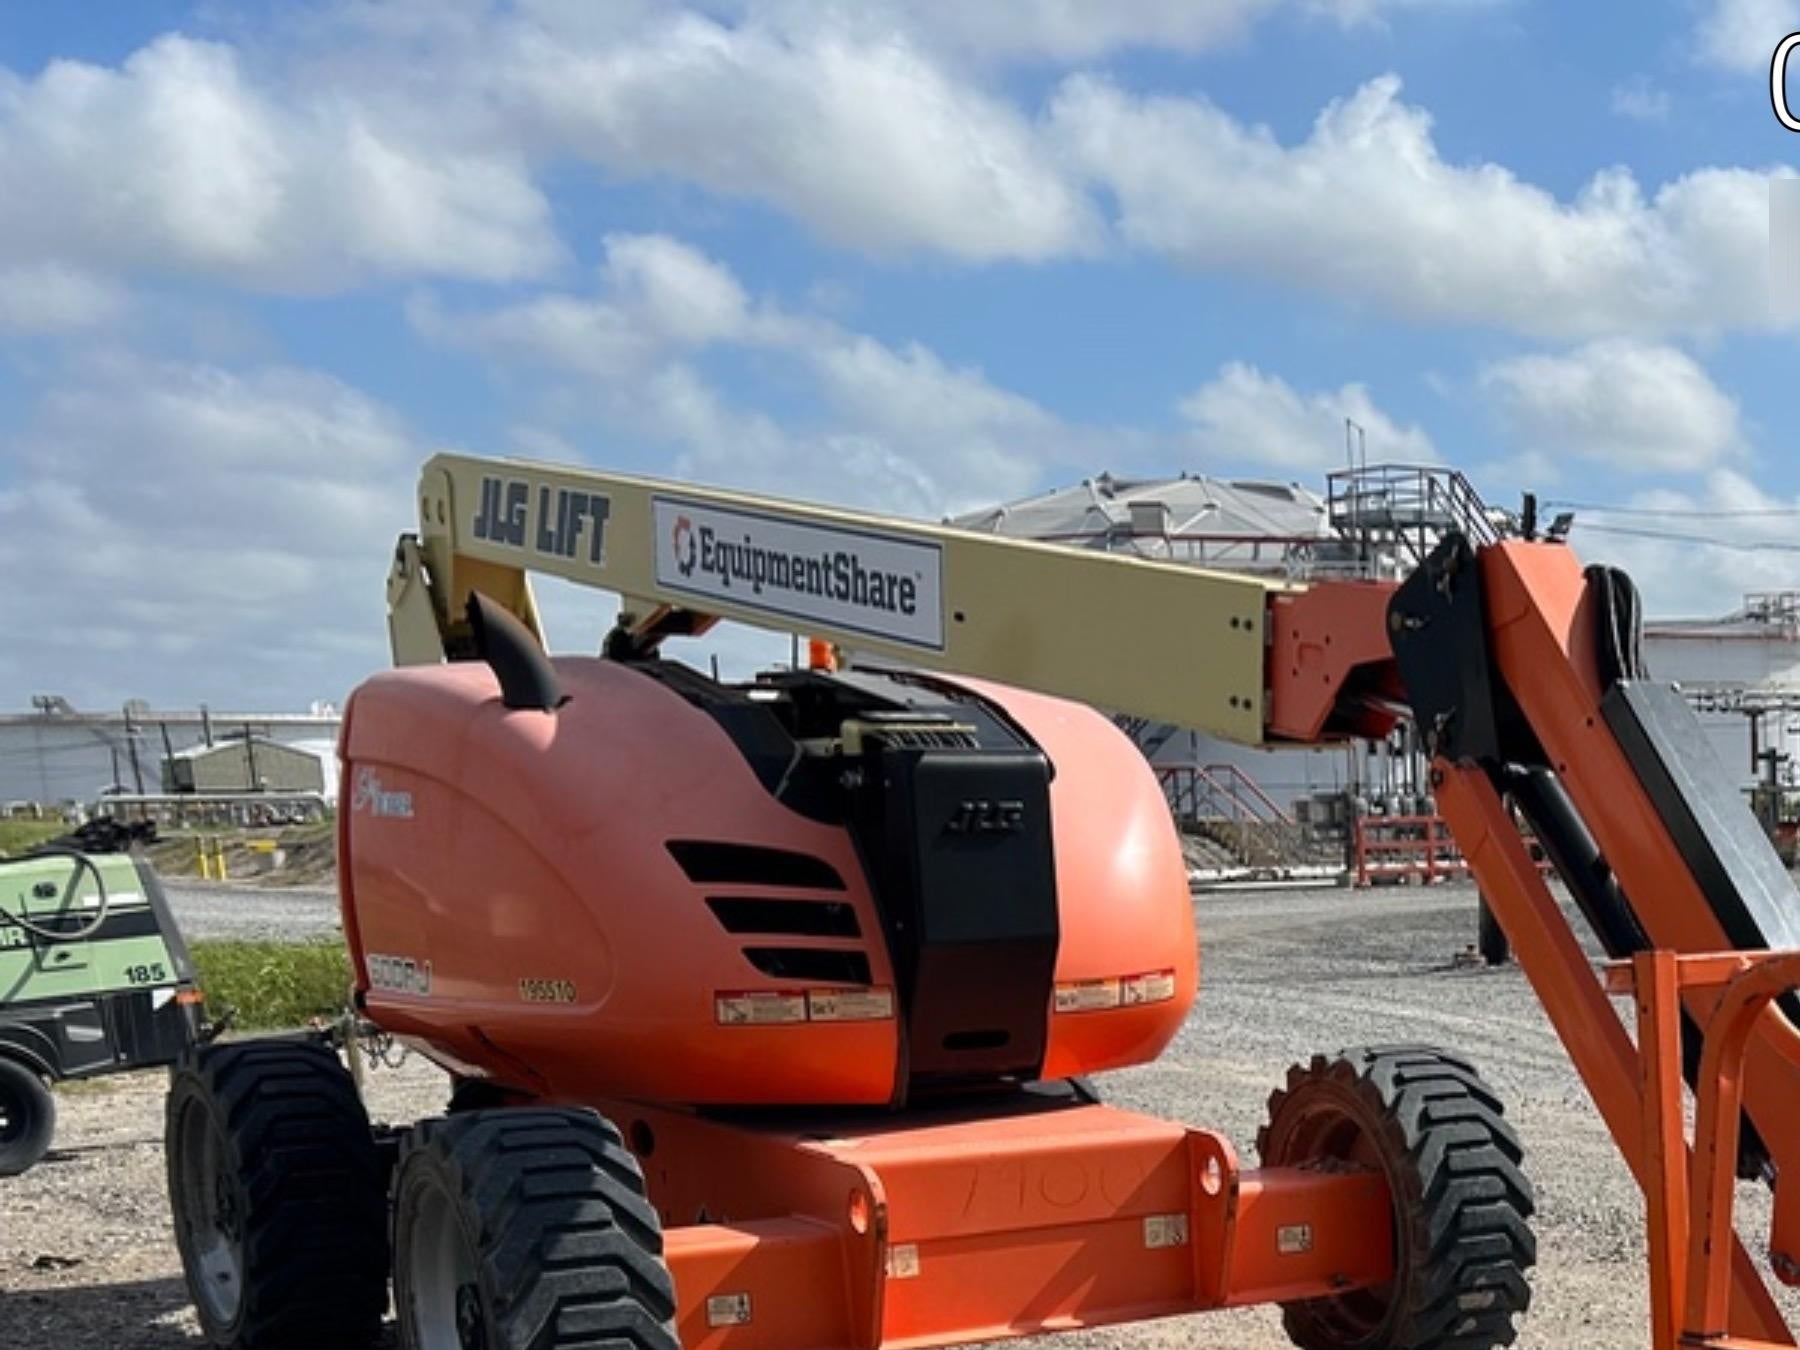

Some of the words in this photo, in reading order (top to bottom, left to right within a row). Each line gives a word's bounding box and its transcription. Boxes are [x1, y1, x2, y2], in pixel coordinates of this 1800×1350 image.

[473, 475, 529, 548] JLG
[536, 485, 610, 566] LIFT
[699, 525, 917, 616] EquipmentShare
[124, 961, 166, 985] 185
